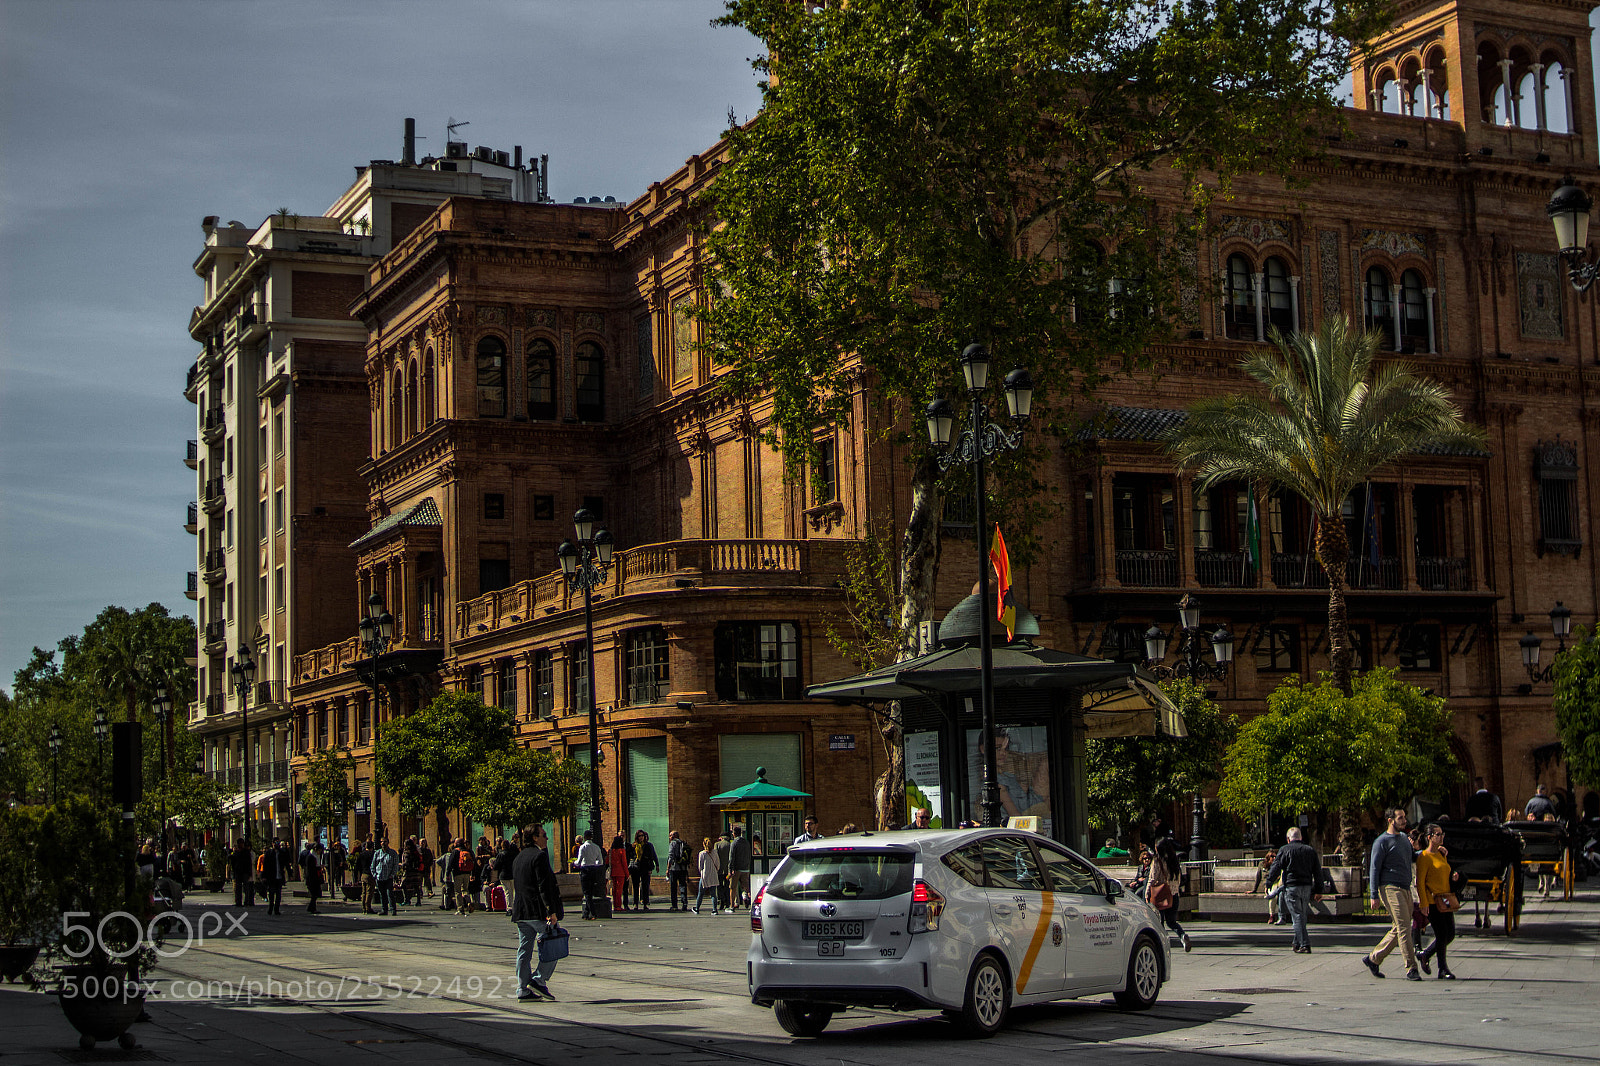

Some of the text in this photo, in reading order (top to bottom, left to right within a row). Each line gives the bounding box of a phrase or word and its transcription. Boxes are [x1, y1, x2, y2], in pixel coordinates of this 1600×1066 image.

[1015, 819, 1031, 829] TAXI
[1083, 914, 1100, 926] Toyota
[809, 922, 862, 936] 9865 KGG
[772, 946, 779, 954] D
[879, 948, 897, 957] 1057
